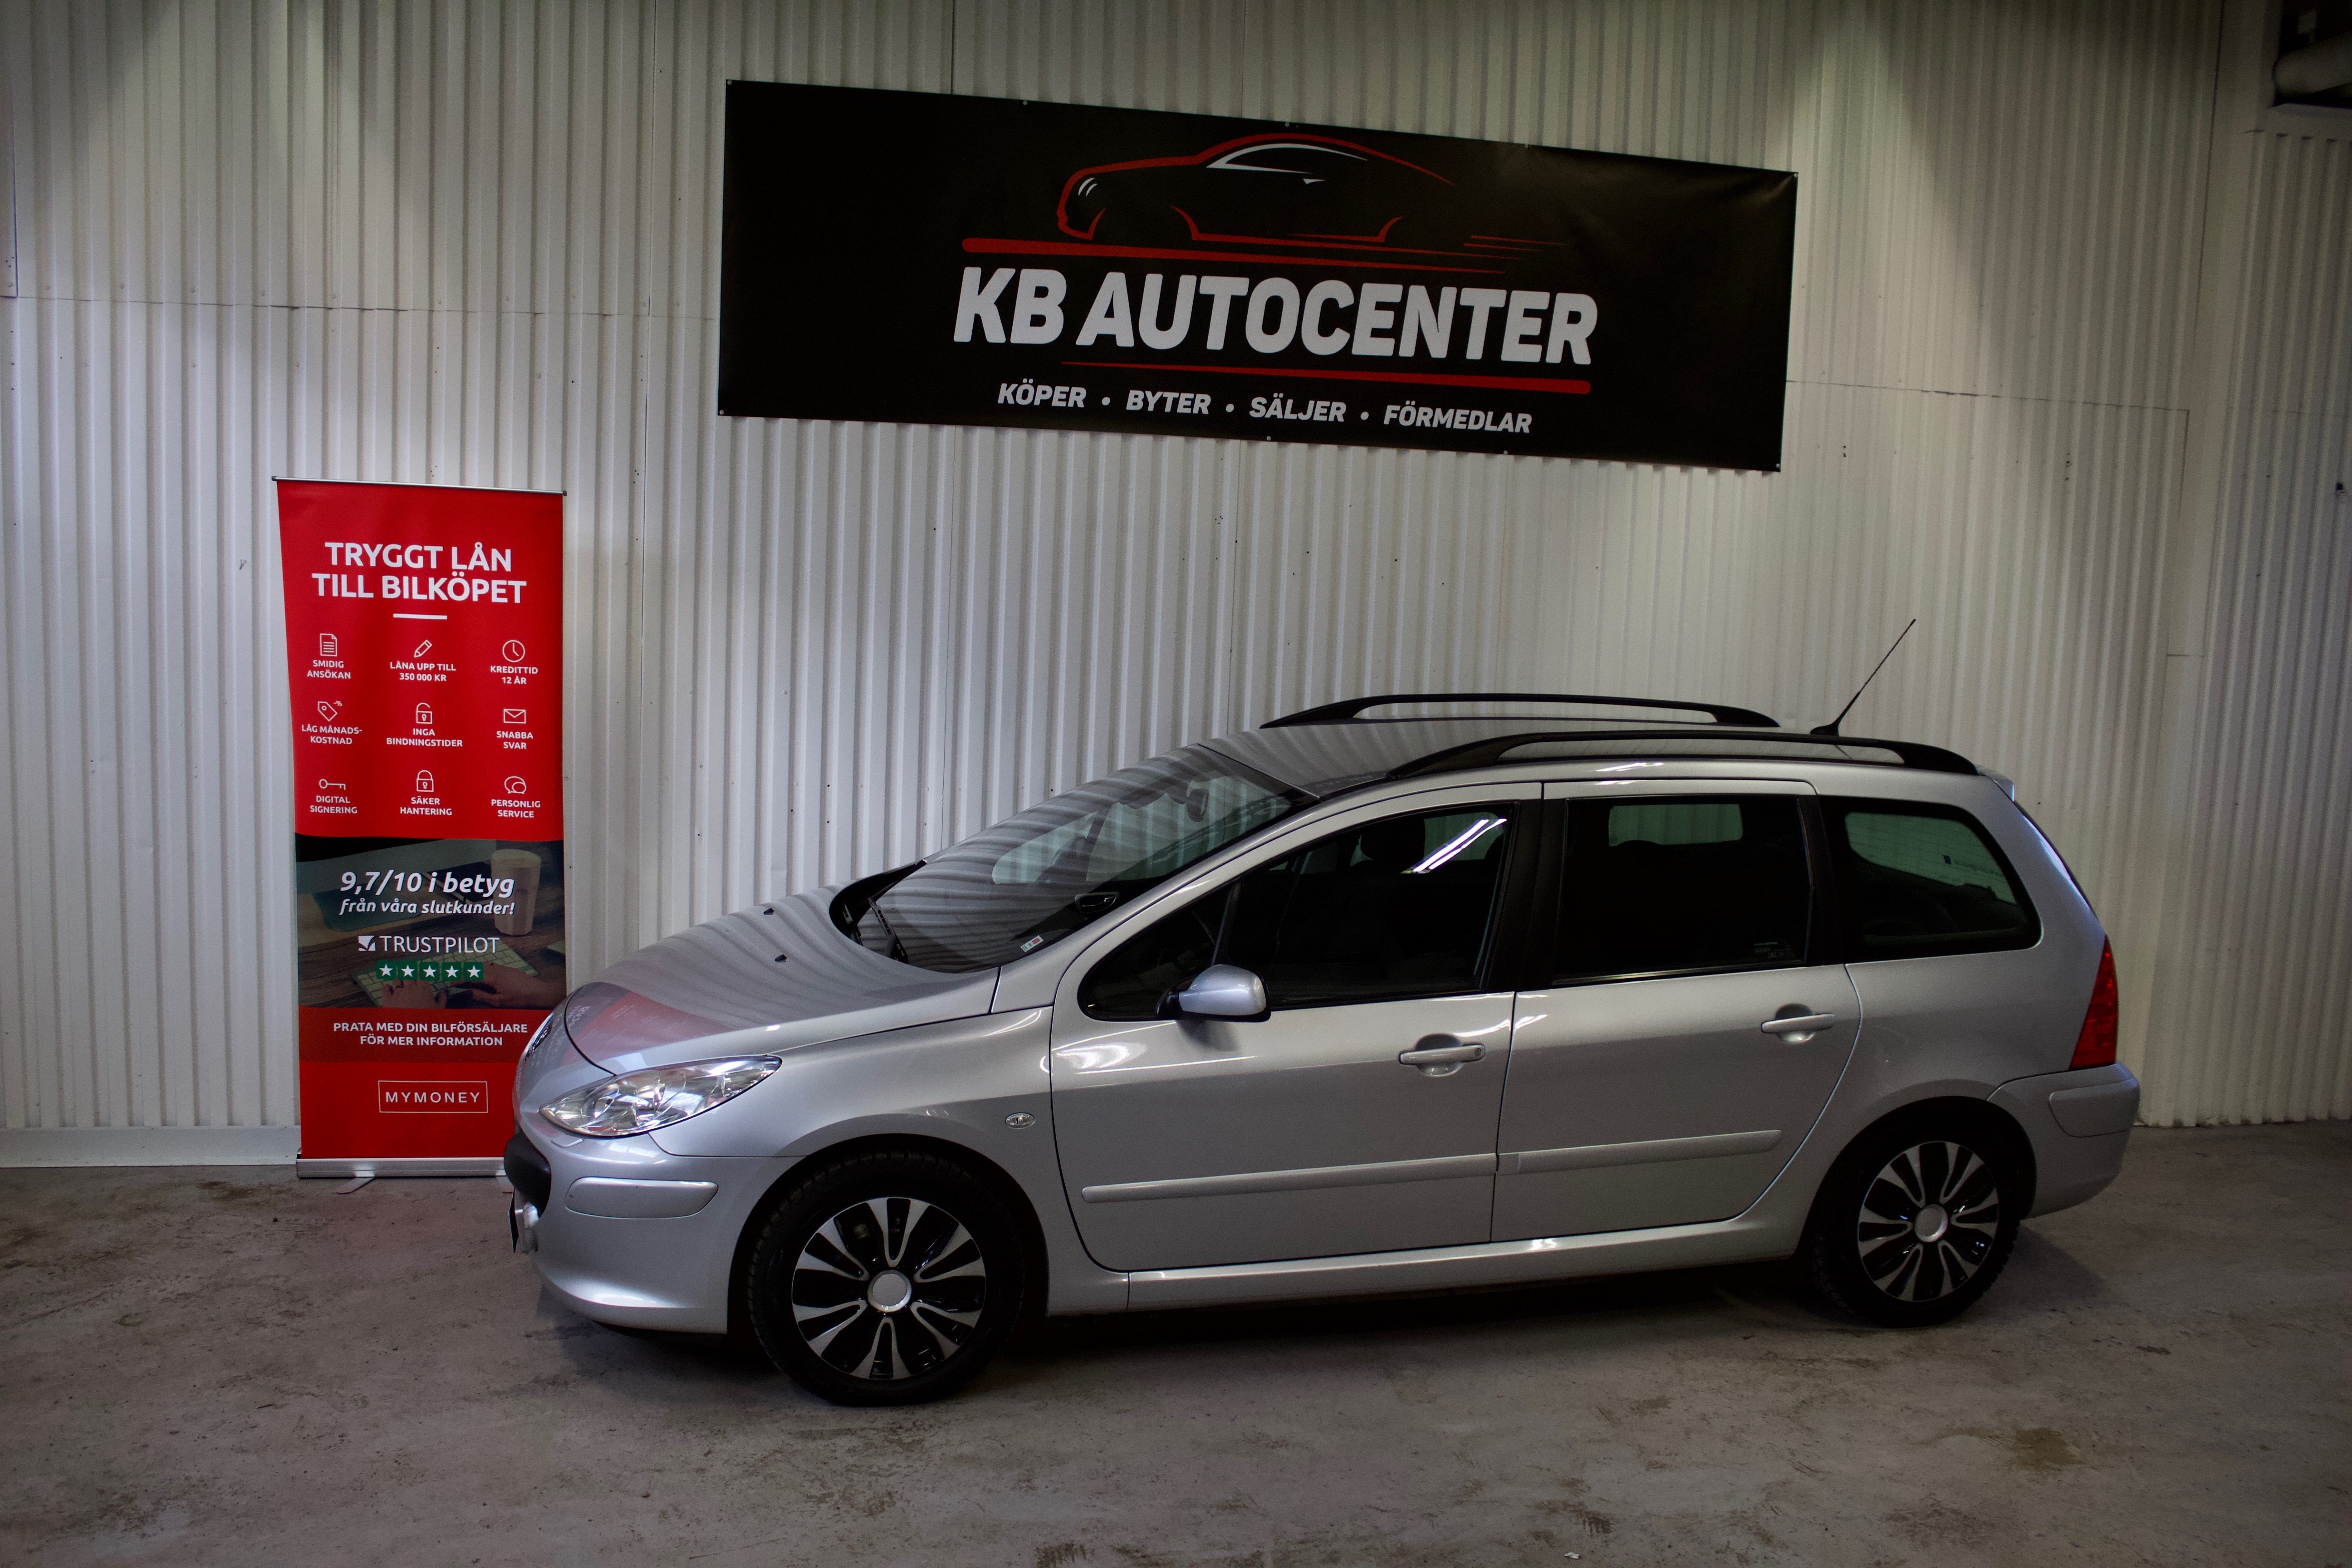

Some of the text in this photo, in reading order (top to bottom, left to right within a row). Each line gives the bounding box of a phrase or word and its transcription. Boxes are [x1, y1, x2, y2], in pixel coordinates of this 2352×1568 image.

[953, 267, 1598, 365] KB AUTOCENTER
[997, 378, 1532, 433] KÖPER BYTER SÄLJER FÖRMEDLAR
[324, 542, 511, 572] TRYGGT LÅN
[312, 571, 527, 603] TILL BILKÖPET
[313, 659, 344, 668] SMIDIG
[390, 660, 415, 670] LÅNA
[307, 669, 351, 679] ANSÖKAN
[490, 665, 538, 674] KREDITTID
[399, 672, 415, 681] 350
[416, 673, 432, 681] 000
[514, 675, 527, 685] ÅR
[302, 723, 363, 734] LÅG MÅNADS-
[413, 728, 436, 736] INGA
[496, 730, 534, 739] SNABBA
[310, 735, 353, 745] KOSTNAD
[387, 737, 463, 747] BINDNINGSTIDER
[503, 741, 527, 750] SVAR
[316, 795, 351, 804] DIGITAL
[411, 795, 440, 805] SÄKER
[491, 799, 541, 808] PERSONLIG
[310, 805, 358, 814] SIGNERING
[400, 807, 452, 815] HANTERING
[498, 809, 534, 818] SERVICE
[341, 869, 514, 898] 9,7/10 i betyg
[339, 897, 515, 915] från våra slutkunder!
[379, 936, 500, 953] TRUSTPILOT
[333, 1021, 528, 1033] PRATA MED DIN BILFÖRSÄLJARE
[360, 1033, 503, 1046] FÖR MER INFORMATION
[386, 1092, 480, 1103] MYMONEY
